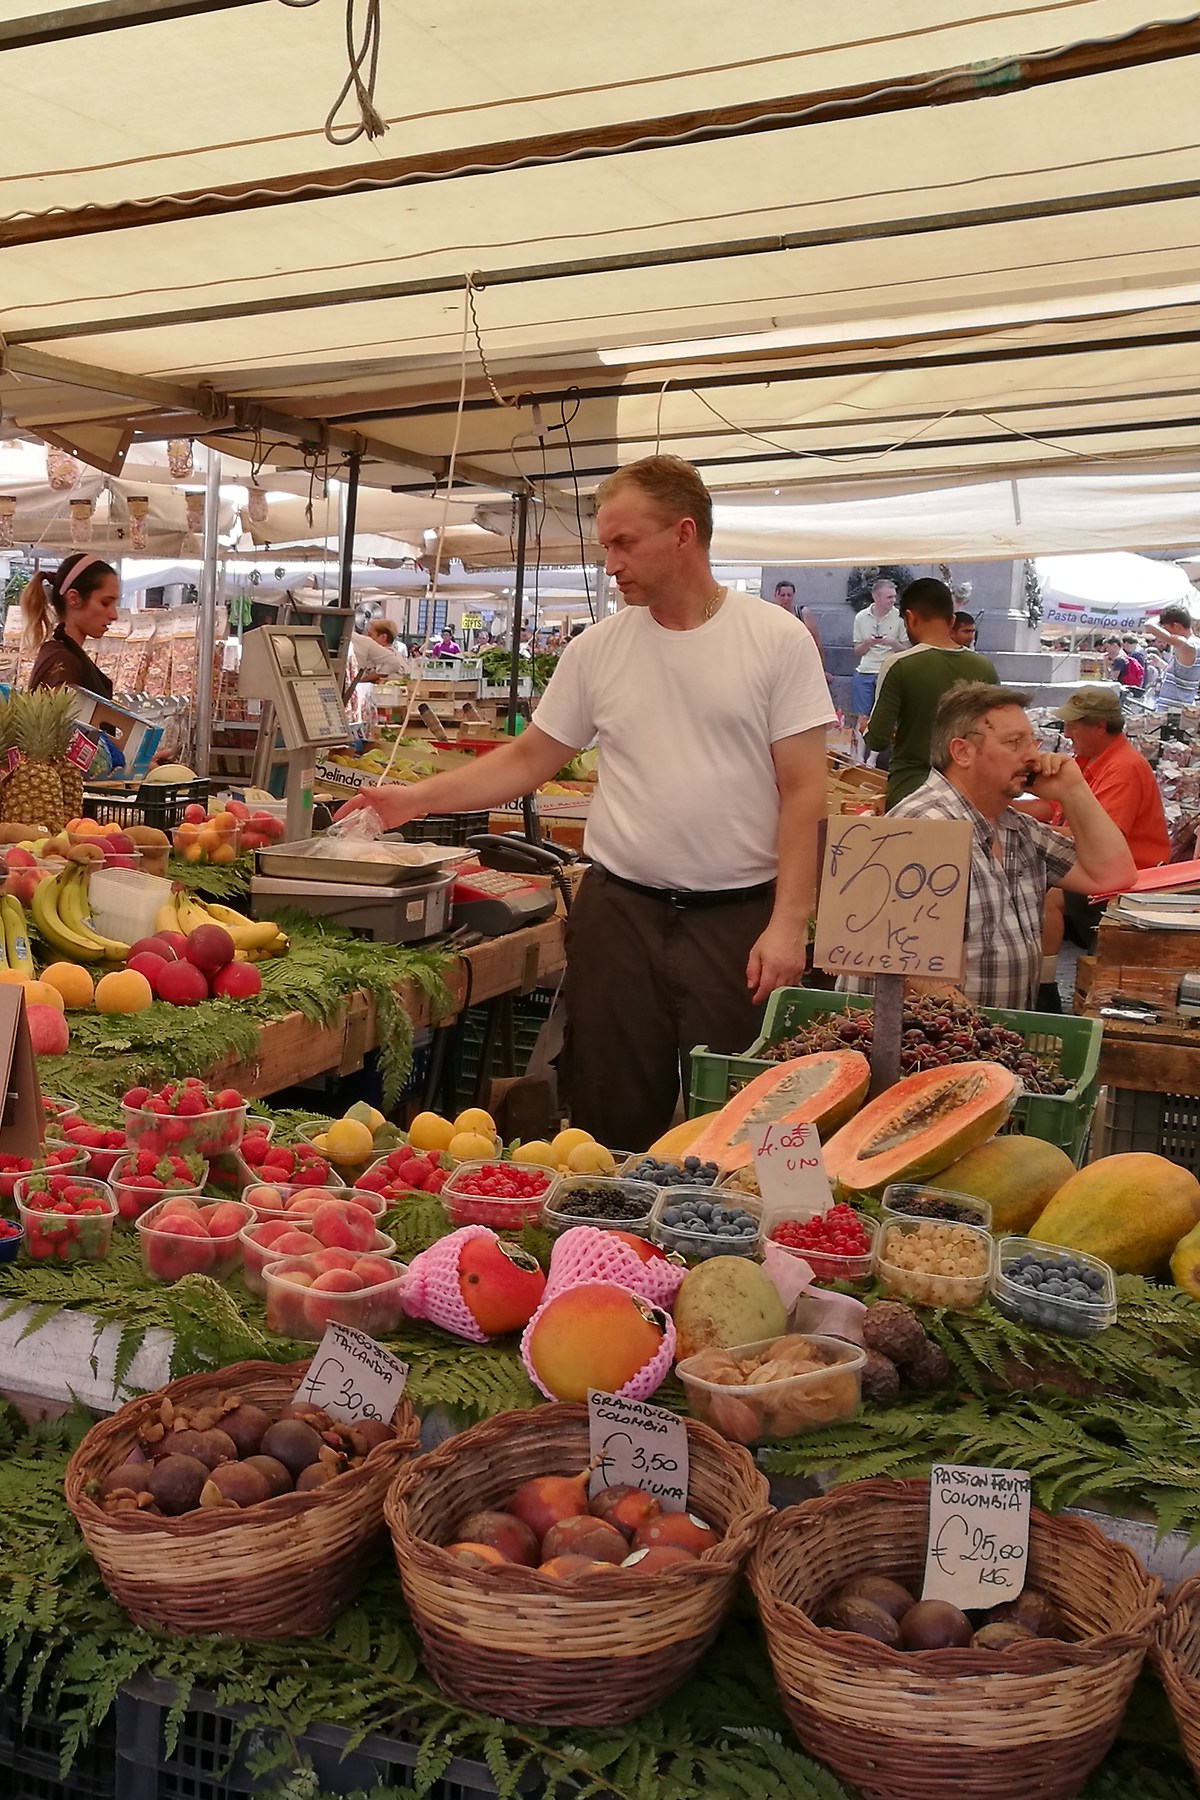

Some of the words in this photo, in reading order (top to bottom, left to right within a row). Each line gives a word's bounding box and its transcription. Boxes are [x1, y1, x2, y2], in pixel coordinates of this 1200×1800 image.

[462, 619, 482, 628] GIFTS
[1047, 609, 1077, 623] Pasta
[1080, 613, 1118, 627] Campo
